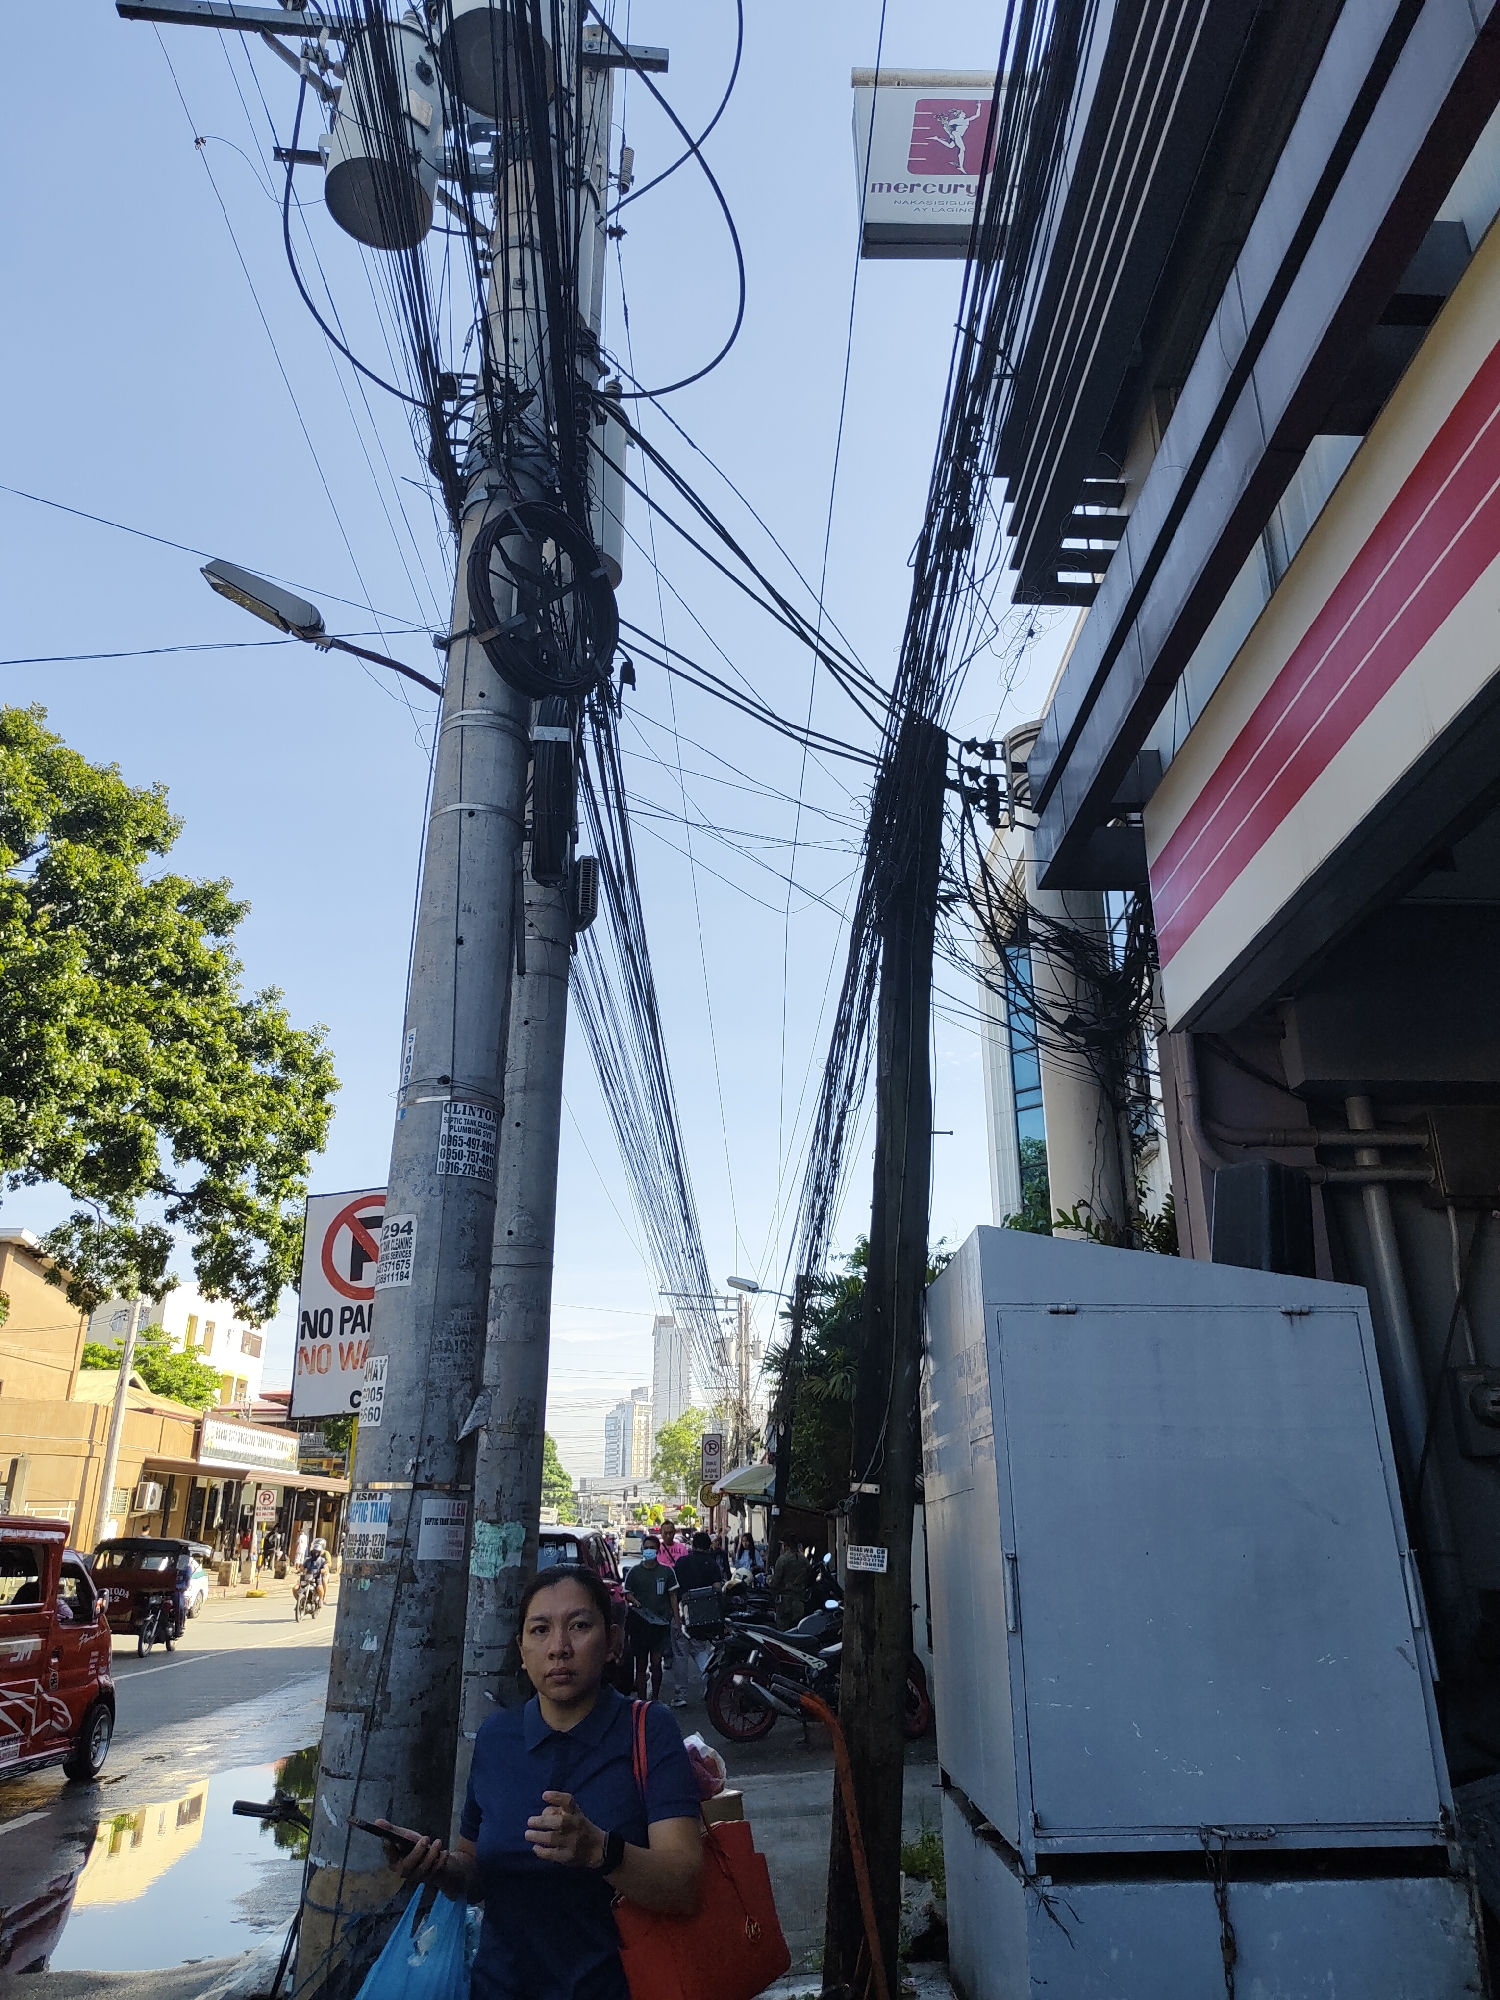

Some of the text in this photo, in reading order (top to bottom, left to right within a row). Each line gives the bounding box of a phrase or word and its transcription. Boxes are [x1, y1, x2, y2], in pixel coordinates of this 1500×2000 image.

[871, 182, 977, 197] mercury
[443, 1102, 498, 1123] CLINTON
[464, 1118, 477, 1127] TANK
[450, 1125, 481, 1136] PLUMBING
[380, 1221, 413, 1242] 294
[300, 1307, 333, 1340] NO
[298, 1343, 332, 1375] NO
[370, 1502, 391, 1523] TANK
[109, 1588, 130, 1599] TODA
